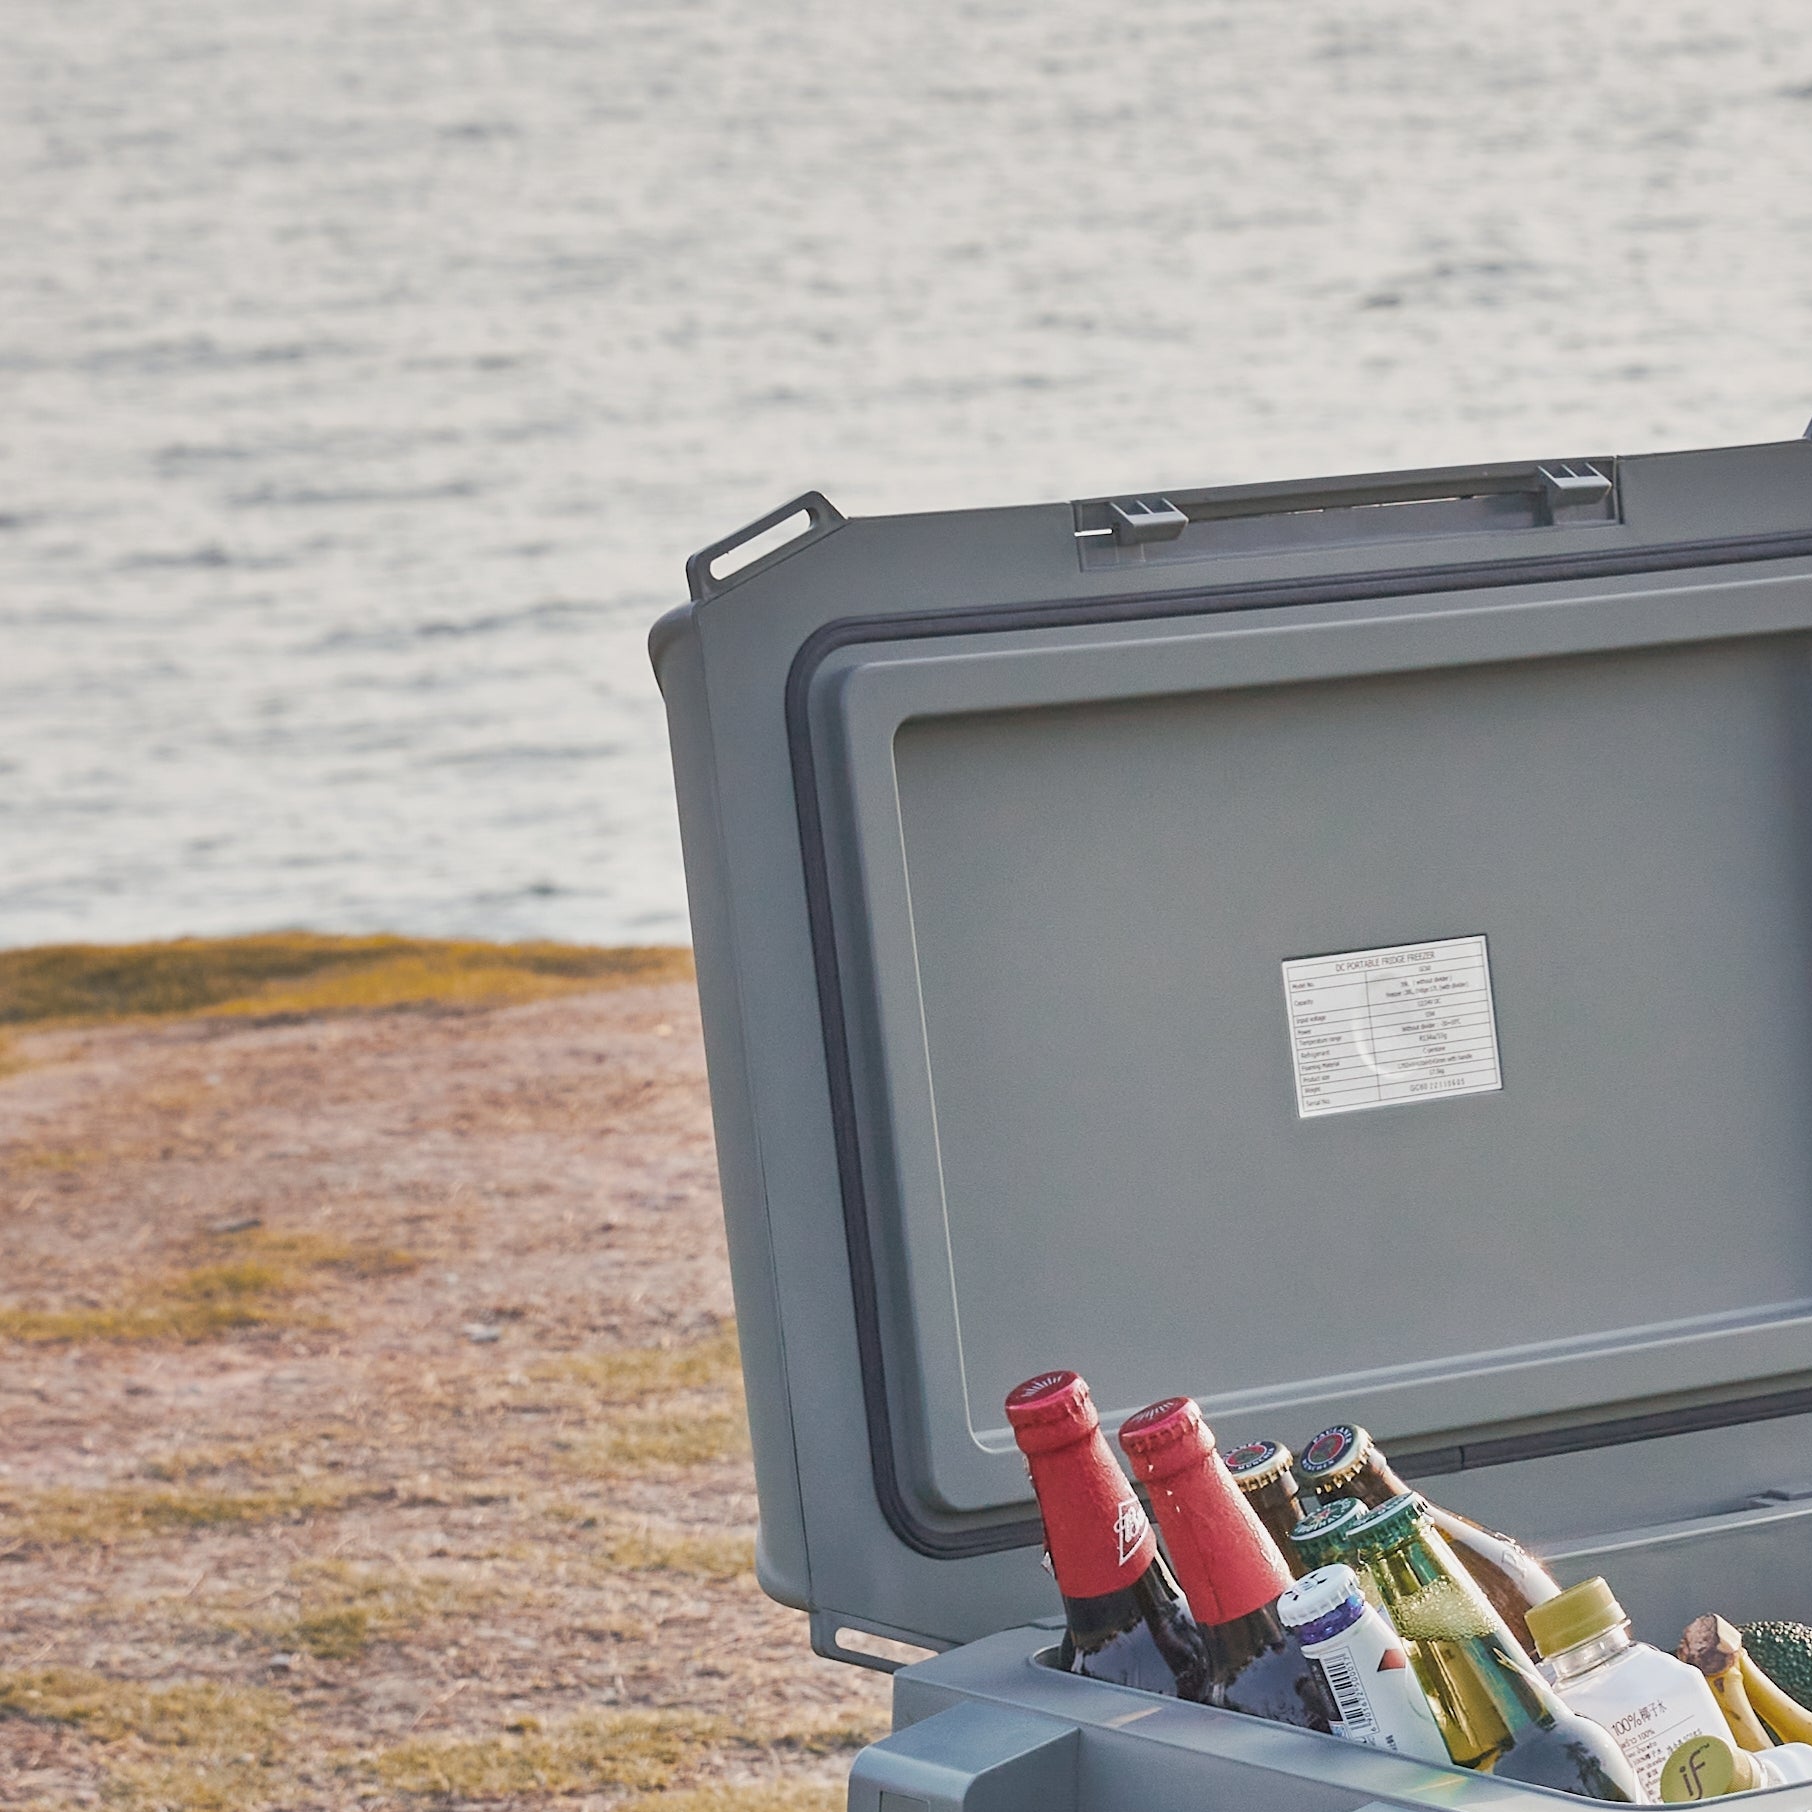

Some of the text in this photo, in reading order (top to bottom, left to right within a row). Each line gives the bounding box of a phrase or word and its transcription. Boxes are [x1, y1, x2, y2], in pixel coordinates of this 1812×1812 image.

[1336, 951, 1435, 972] DC PORTABLE FRIDGE FREEZER
